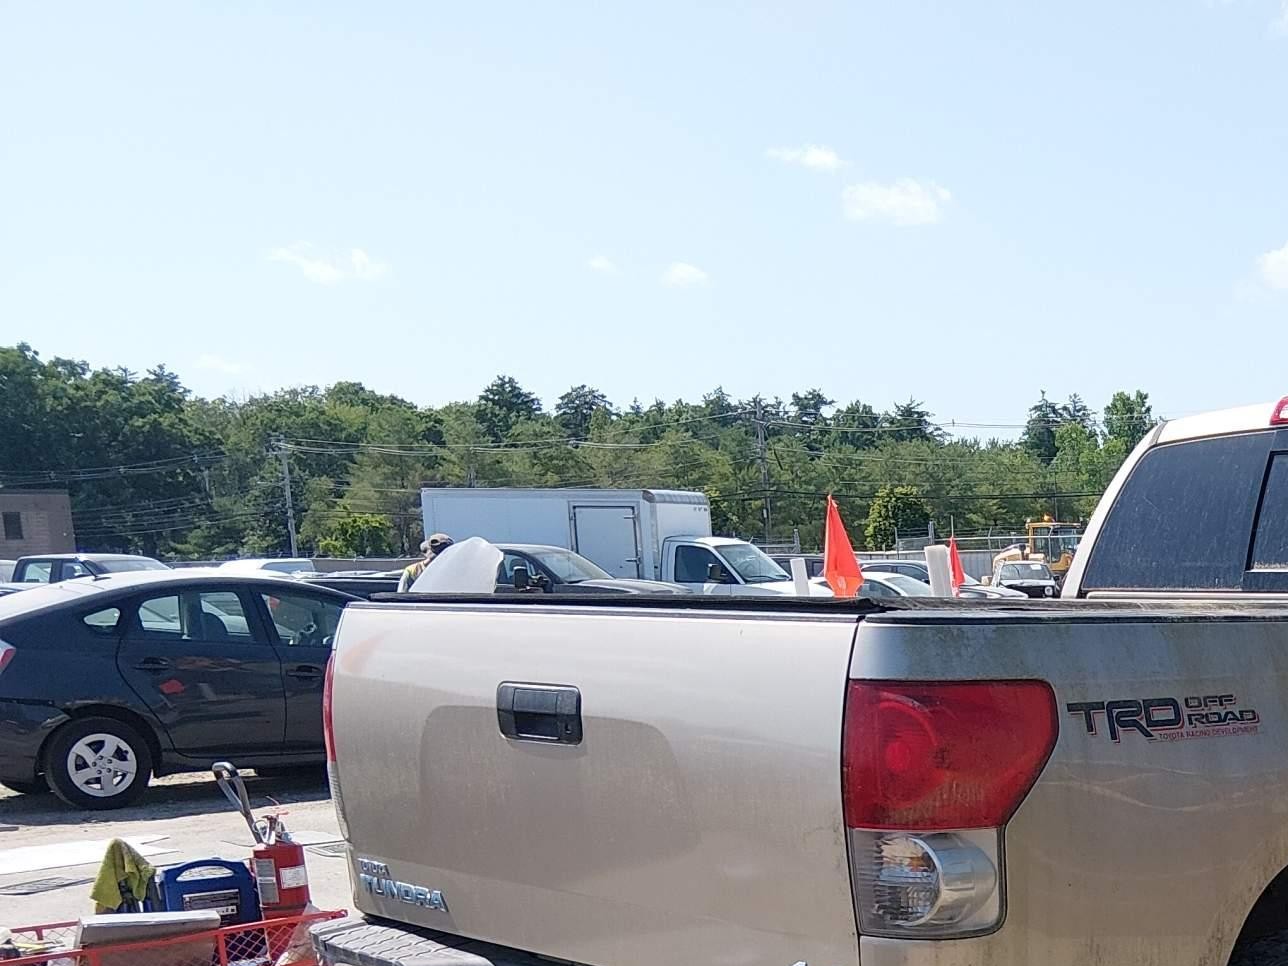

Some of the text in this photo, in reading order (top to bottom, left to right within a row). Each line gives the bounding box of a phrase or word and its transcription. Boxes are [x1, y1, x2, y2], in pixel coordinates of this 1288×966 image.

[1066, 694, 1236, 743] TRD OFF
[1187, 709, 1260, 728] ROAD
[359, 872, 449, 913] TUNDRA
